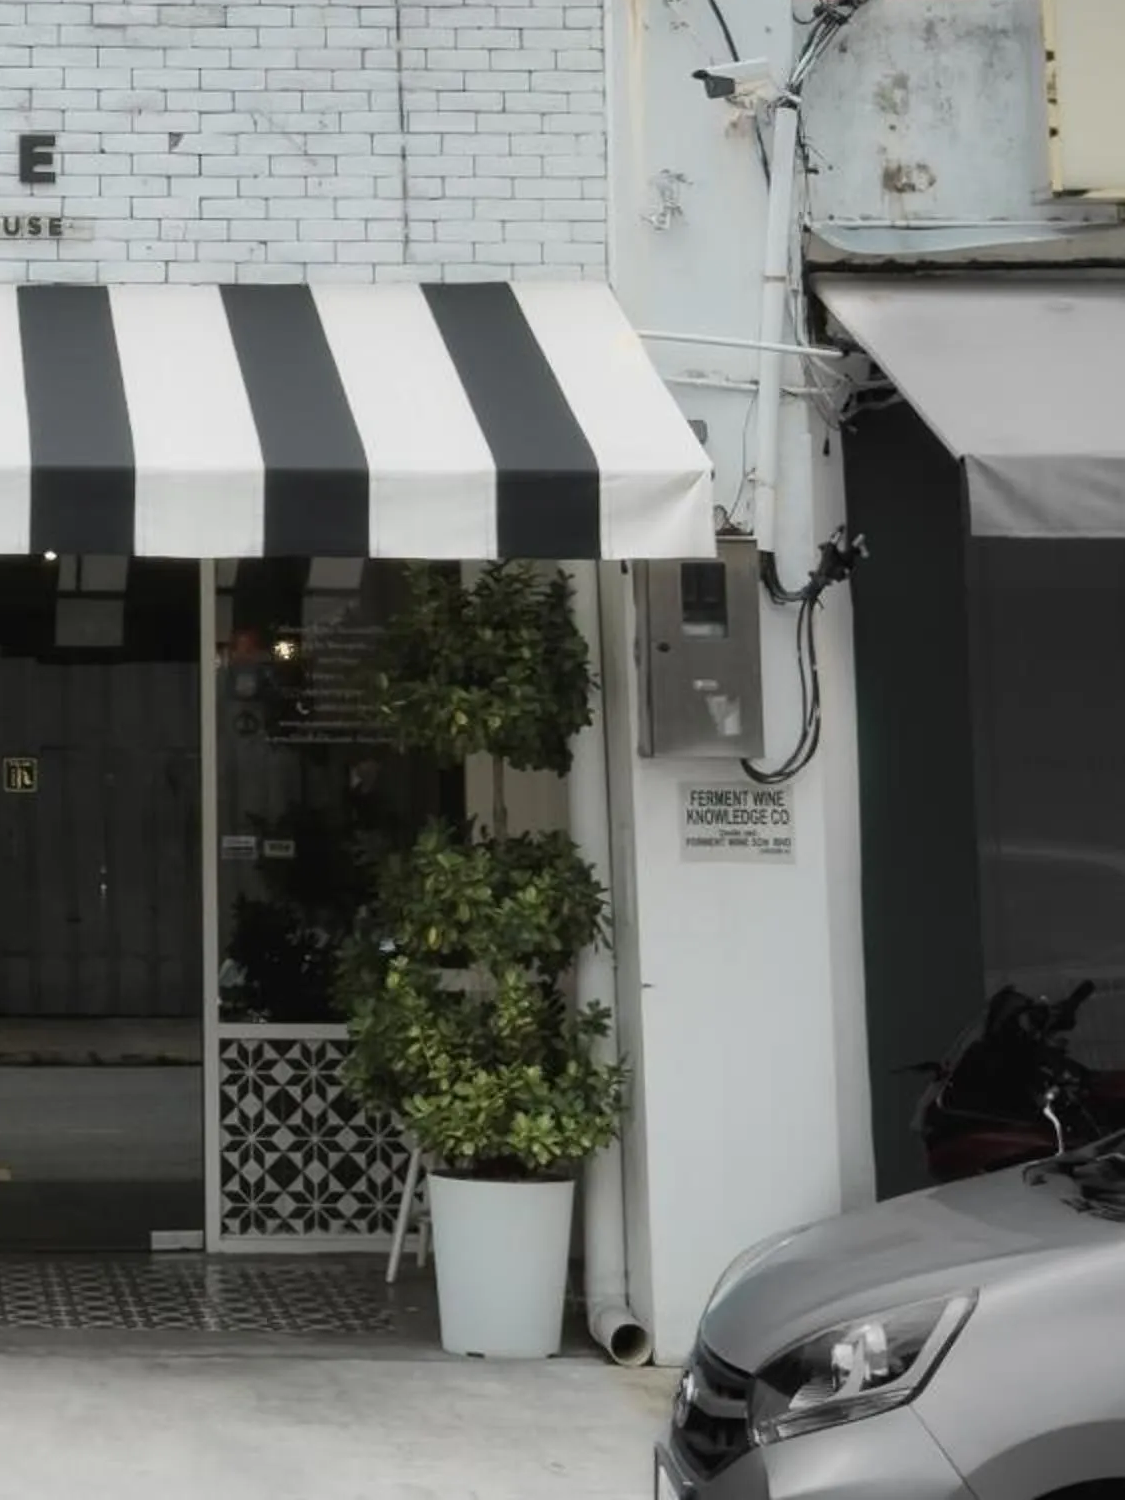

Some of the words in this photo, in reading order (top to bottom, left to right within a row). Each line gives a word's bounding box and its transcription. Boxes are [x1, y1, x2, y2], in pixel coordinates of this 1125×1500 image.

[690, 789, 748, 807] FERMENT
[753, 789, 785, 807] WINE
[685, 807, 768, 825] KNOWLEDGE
[770, 808, 791, 825] CO
